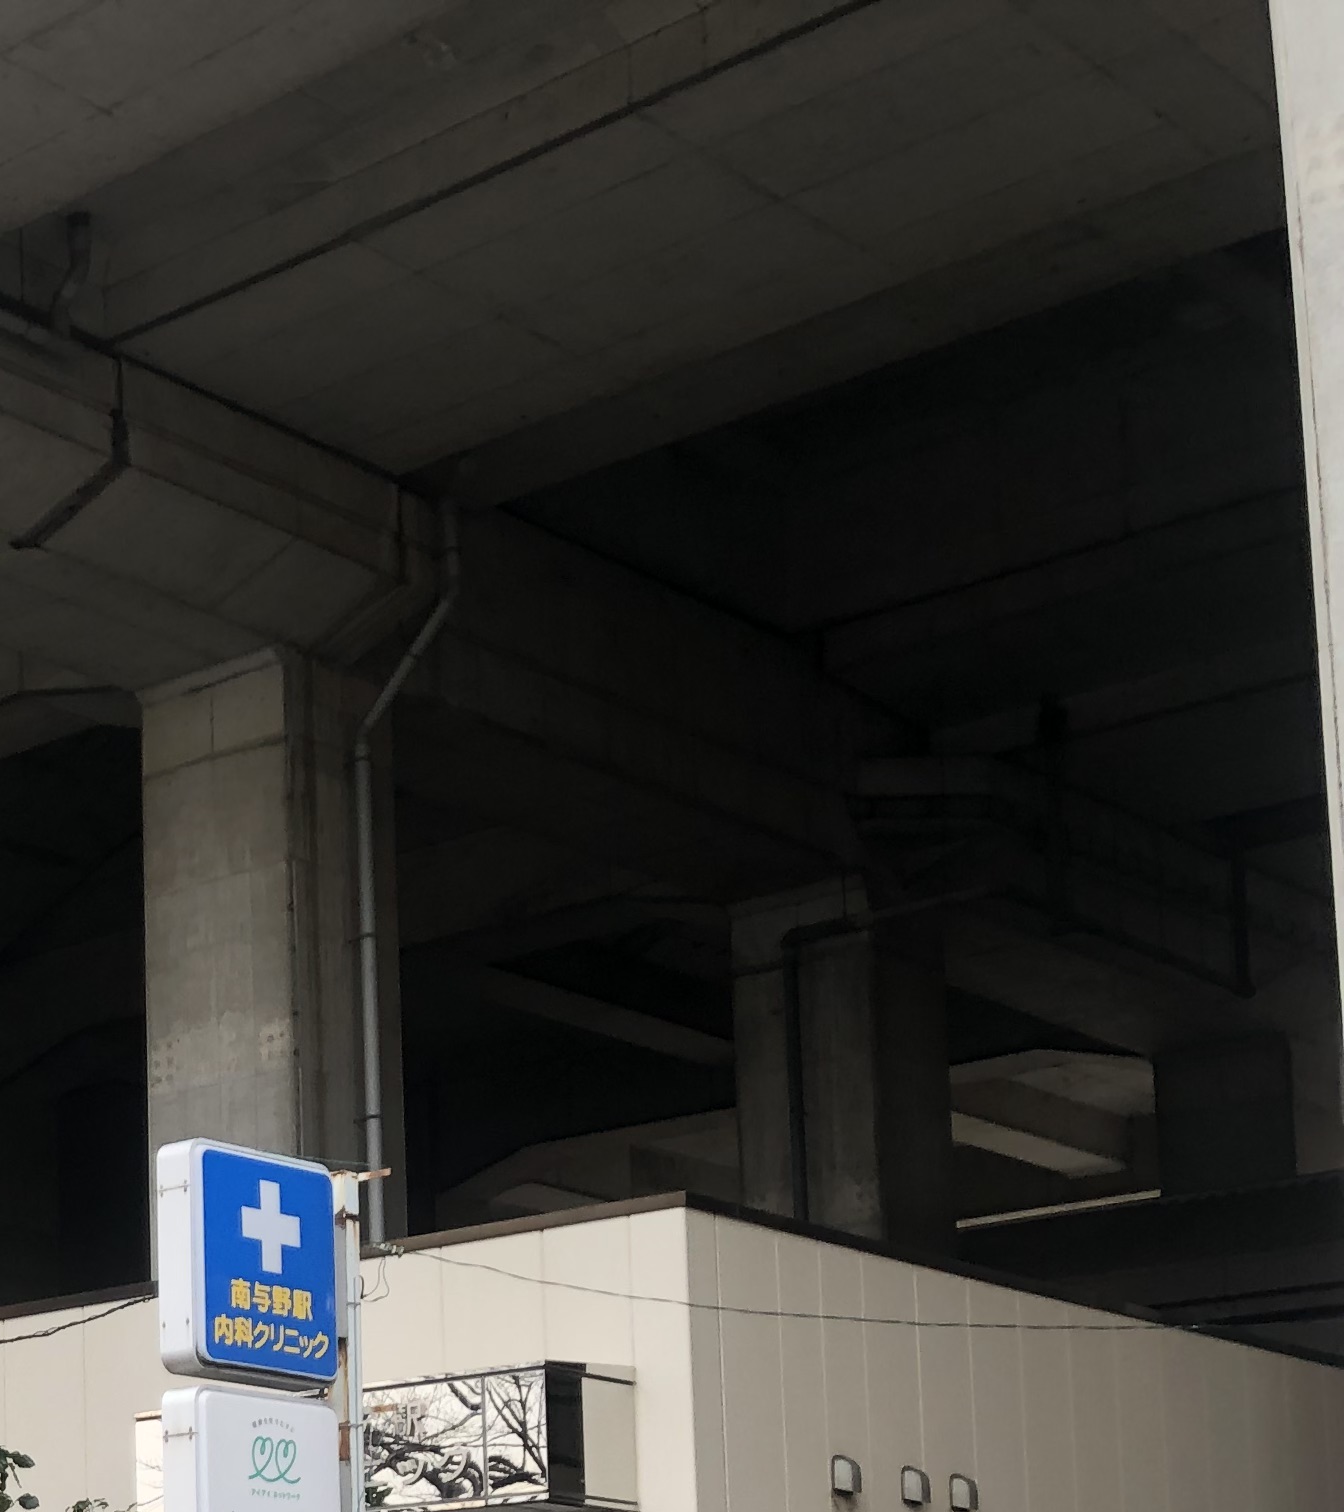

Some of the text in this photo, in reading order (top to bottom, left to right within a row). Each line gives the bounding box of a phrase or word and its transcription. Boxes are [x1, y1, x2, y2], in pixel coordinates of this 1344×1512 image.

[230, 1278, 313, 1321] 南与野駅
[214, 1314, 329, 1359] 内科クリニック
